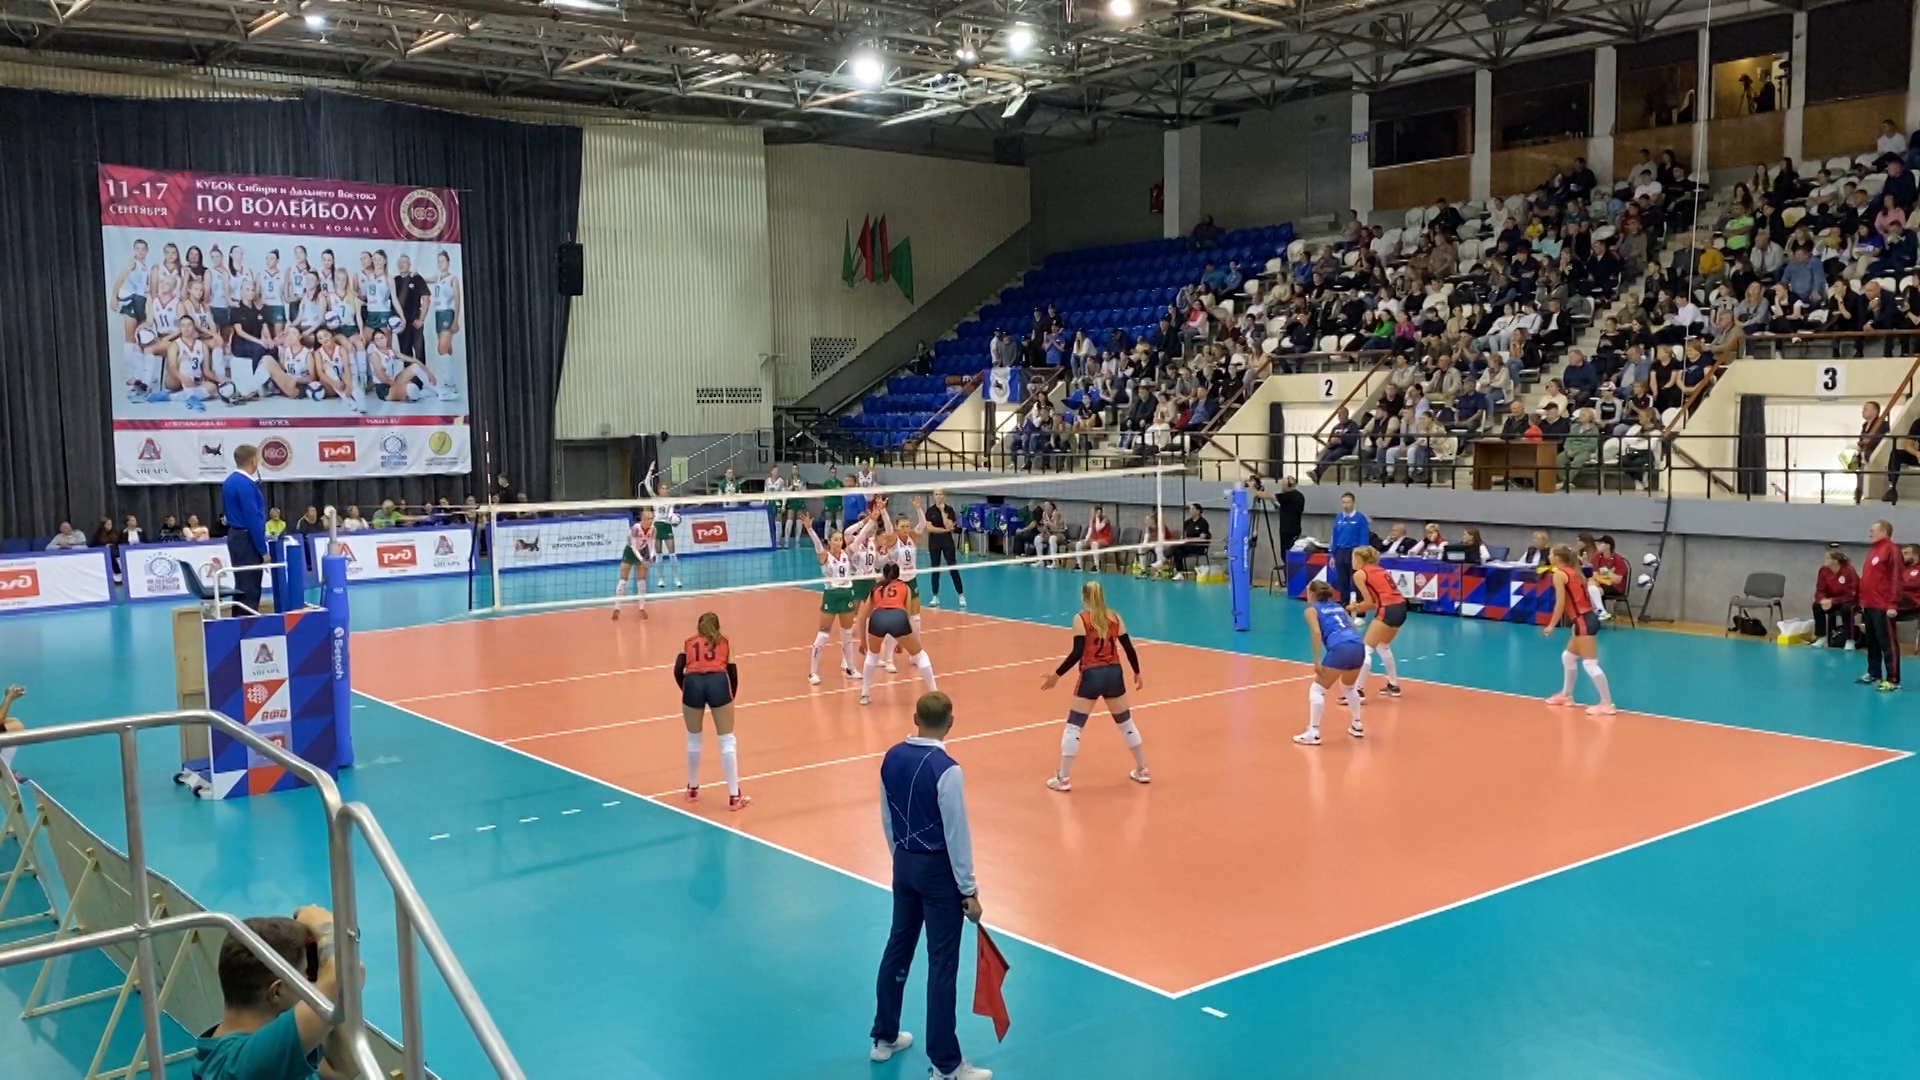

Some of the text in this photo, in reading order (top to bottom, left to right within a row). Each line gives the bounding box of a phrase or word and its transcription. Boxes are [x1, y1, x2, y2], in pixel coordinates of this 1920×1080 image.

[105, 179, 169, 200] 11-17
[195, 179, 235, 192] КУБОК
[196, 195, 234, 214] ПО
[241, 197, 377, 222] ВОЛЕЙБОЛУ
[198, 217, 378, 234] СРЕДИ ЖЕНСКИХ КОМАНД
[159, 314, 170, 328] 11
[192, 357, 199, 370] 3
[1324, 379, 1334, 396] 2
[1823, 367, 1838, 391] 3
[865, 553, 875, 566] 10
[1333, 614, 1347, 628] 1
[691, 641, 716, 662] 13
[1094, 635, 1115, 658] 21
